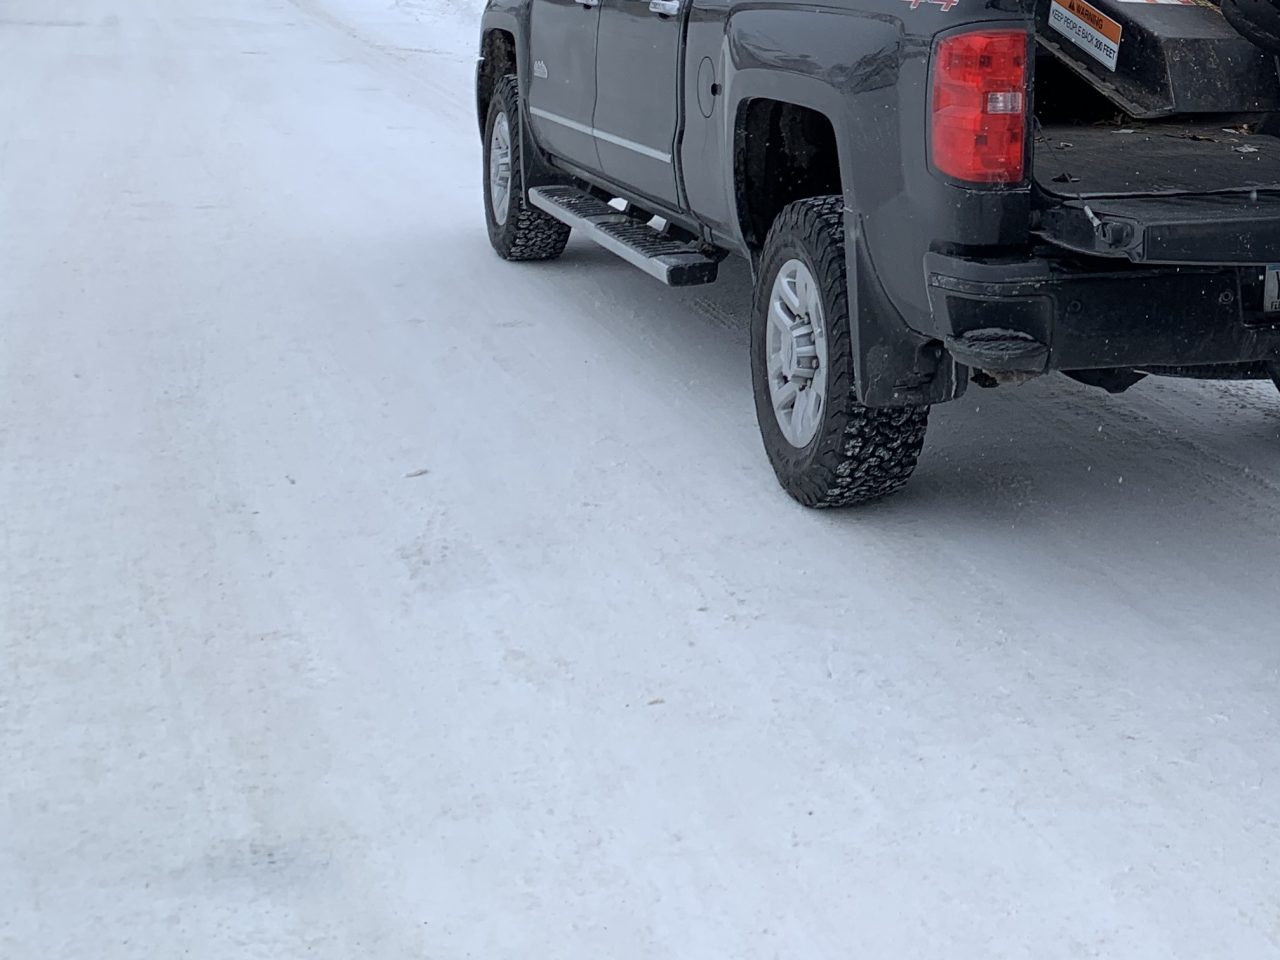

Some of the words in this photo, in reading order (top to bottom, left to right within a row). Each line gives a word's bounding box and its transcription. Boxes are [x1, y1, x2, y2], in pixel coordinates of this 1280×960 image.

[1052, 8, 1064, 23] KEEP
[1063, 15, 1082, 37] PEOPLE
[1081, 27, 1094, 44] BACK
[1102, 43, 1117, 60] FEET
[1076, 7, 1104, 30] WARNING
